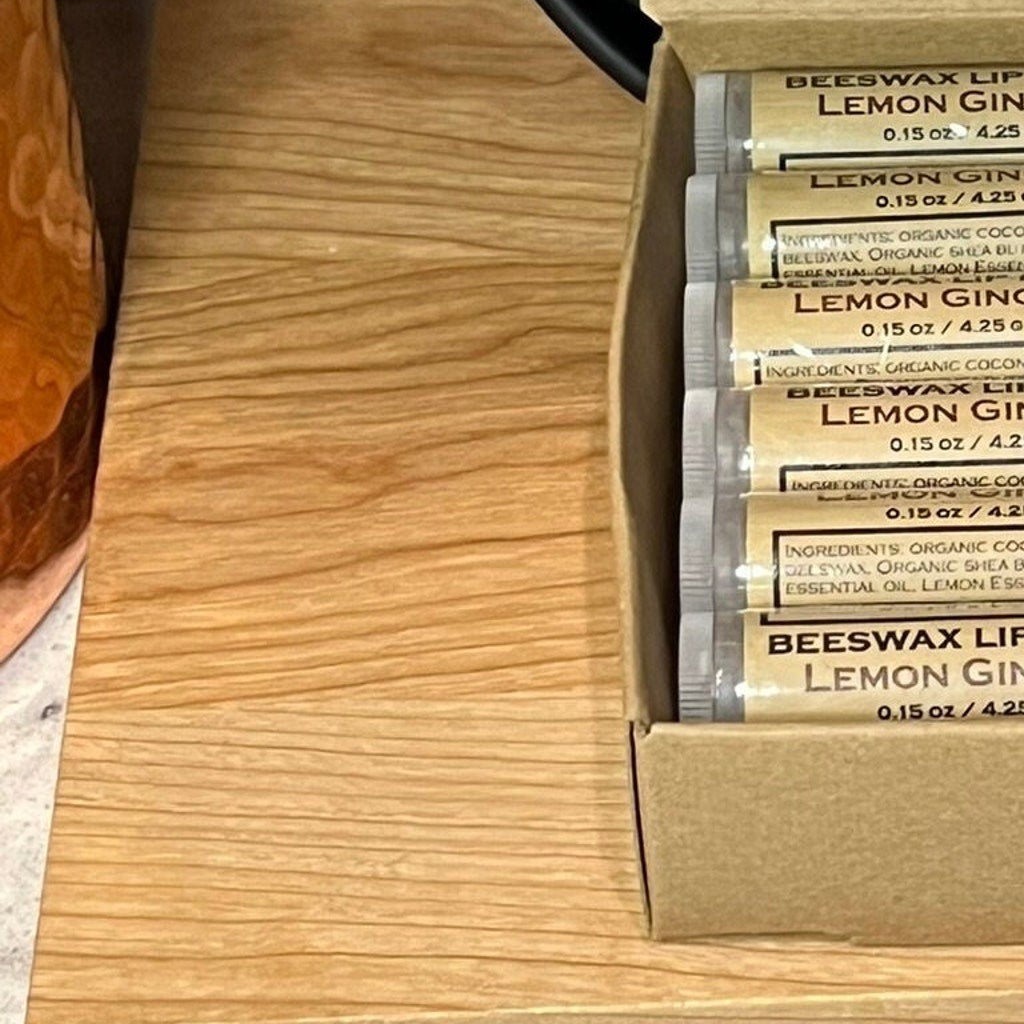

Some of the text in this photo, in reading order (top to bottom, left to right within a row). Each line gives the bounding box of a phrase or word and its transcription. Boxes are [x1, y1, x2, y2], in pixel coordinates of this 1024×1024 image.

[785, 72, 960, 89] BEESWAX
[970, 70, 1024, 85] LIP
[818, 93, 947, 116] LEMON
[883, 126, 924, 141] 0.15
[976, 124, 1020, 139] 4.25
[810, 171, 942, 189] LEMON
[875, 194, 918, 208] 0.15
[898, 228, 971, 243] ORGANIC
[868, 246, 944, 262] ORGANIC
[910, 262, 970, 276] LEMON
[794, 292, 929, 314] LEMON
[861, 322, 905, 337] 0.15
[960, 318, 1005, 333] 4.25
[885, 360, 960, 374] ORGANIC
[786, 382, 971, 399] BEESWAX
[820, 402, 959, 426] LEMON
[889, 436, 933, 452] 0.15
[913, 476, 989, 489] ORGANIC
[885, 506, 932, 520] 0.15
[909, 540, 988, 556] ORGANIC
[876, 559, 959, 575] ORGANIC
[964, 558, 1009, 573] SHEA
[785, 580, 875, 595] ESSENTIAL
[922, 578, 985, 592] LEMON
[767, 628, 963, 655] BEESWAX
[803, 662, 949, 693] LEMON
[877, 703, 924, 721] 0.15
